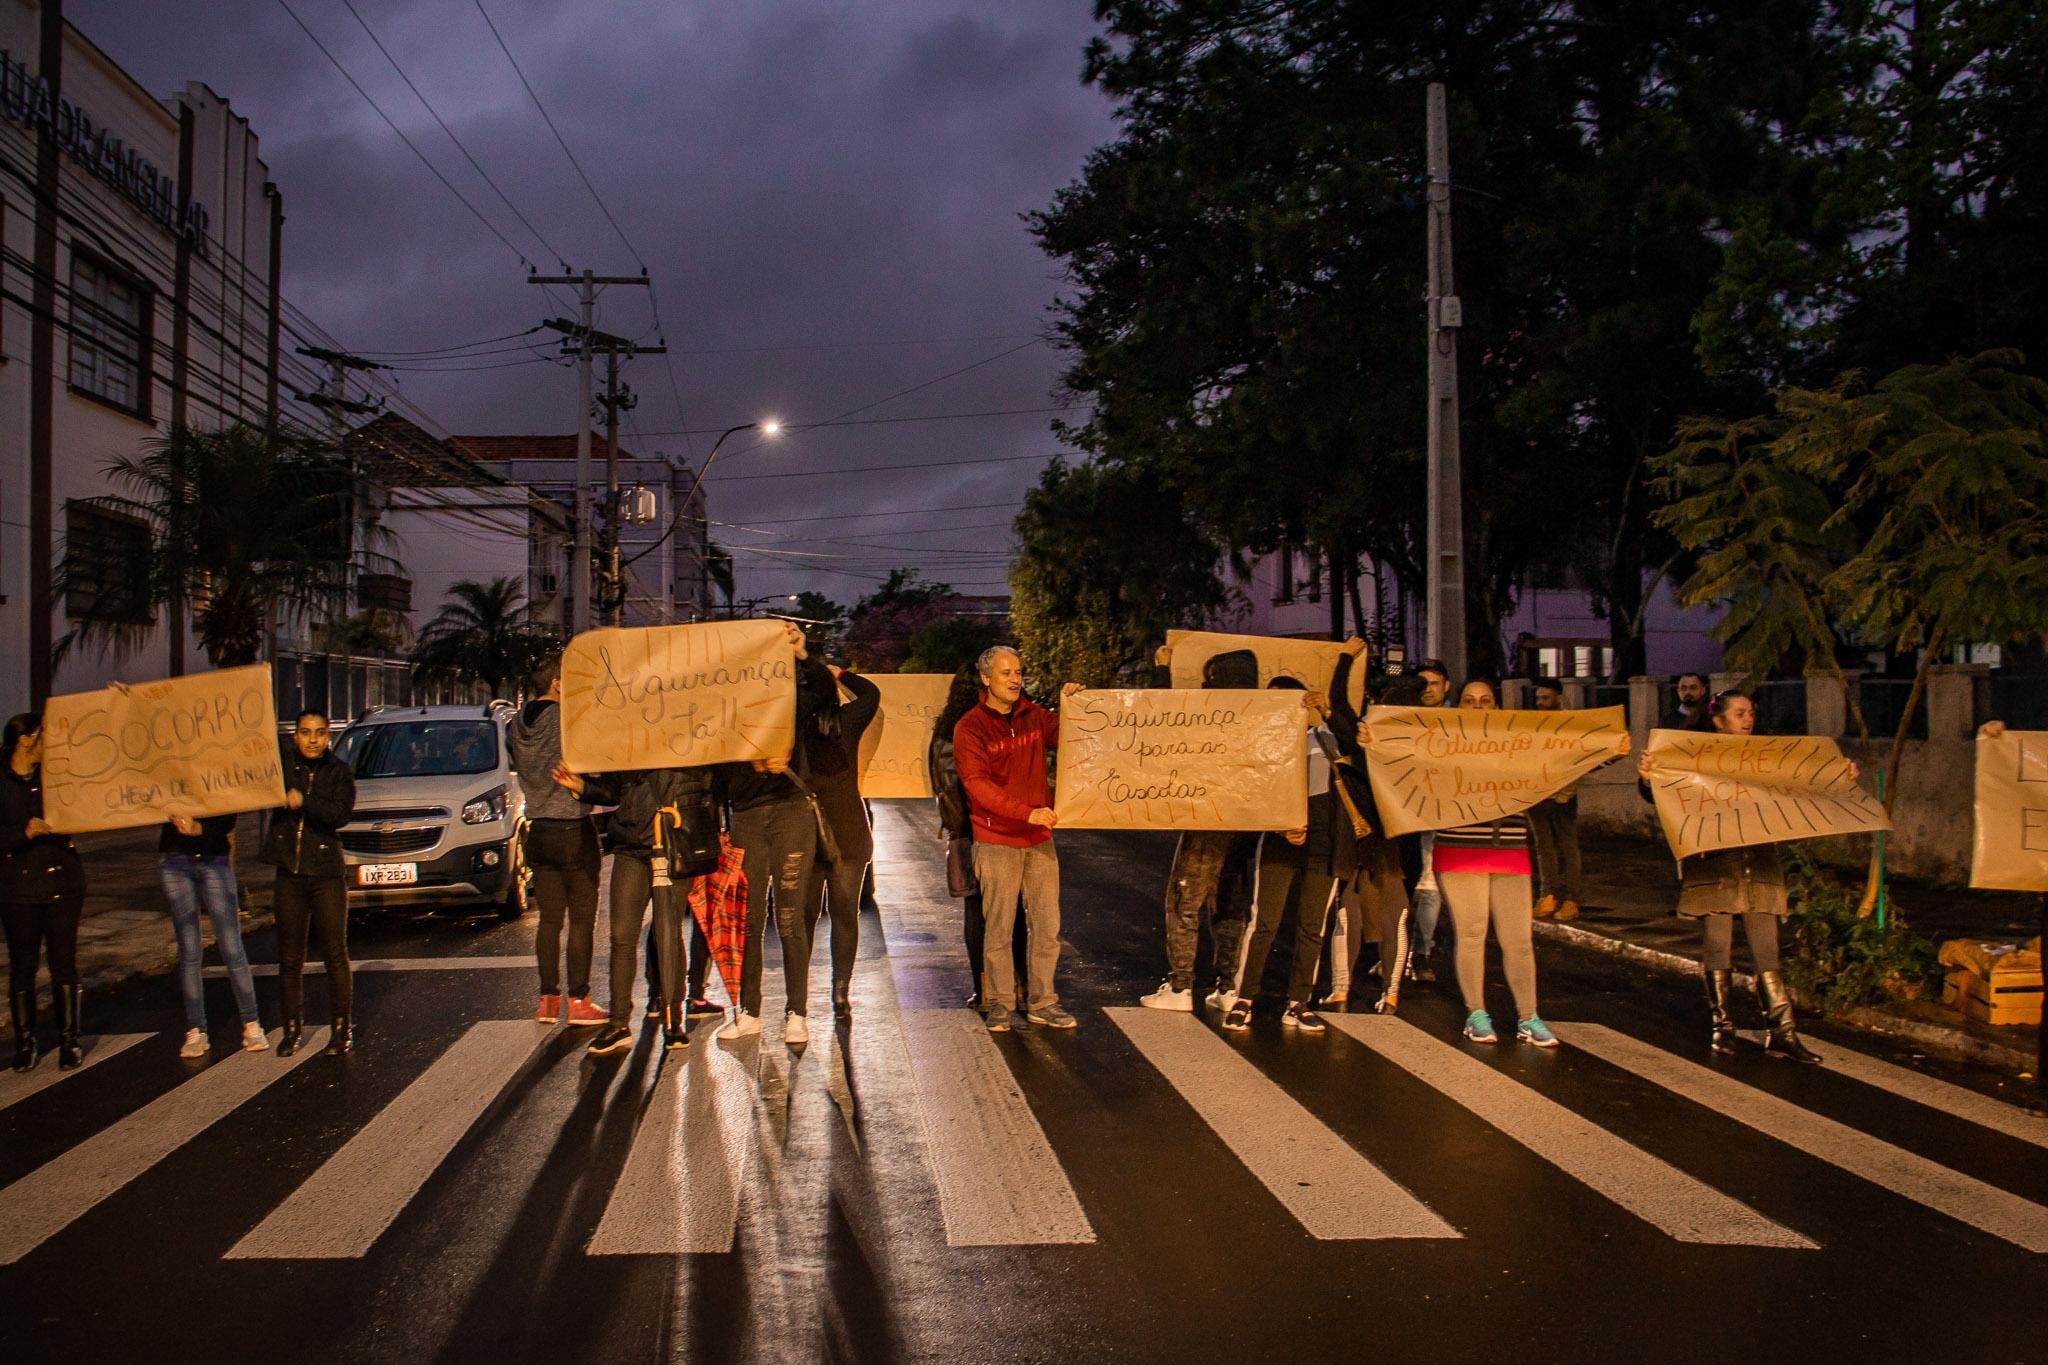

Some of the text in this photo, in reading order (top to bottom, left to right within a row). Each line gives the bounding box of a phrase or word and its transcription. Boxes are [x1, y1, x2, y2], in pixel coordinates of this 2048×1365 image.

[0, 48, 209, 258] UADRANGULAR
[594, 645, 792, 724] Segurança
[67, 687, 265, 779] SOCORRO
[1077, 698, 1240, 752] Segurança
[1414, 724, 1592, 759] Educação em
[1134, 741, 1227, 768] para as
[105, 782, 163, 809] CHEGA
[170, 776, 194, 797] DE
[1674, 780, 1752, 814] FAÇA
